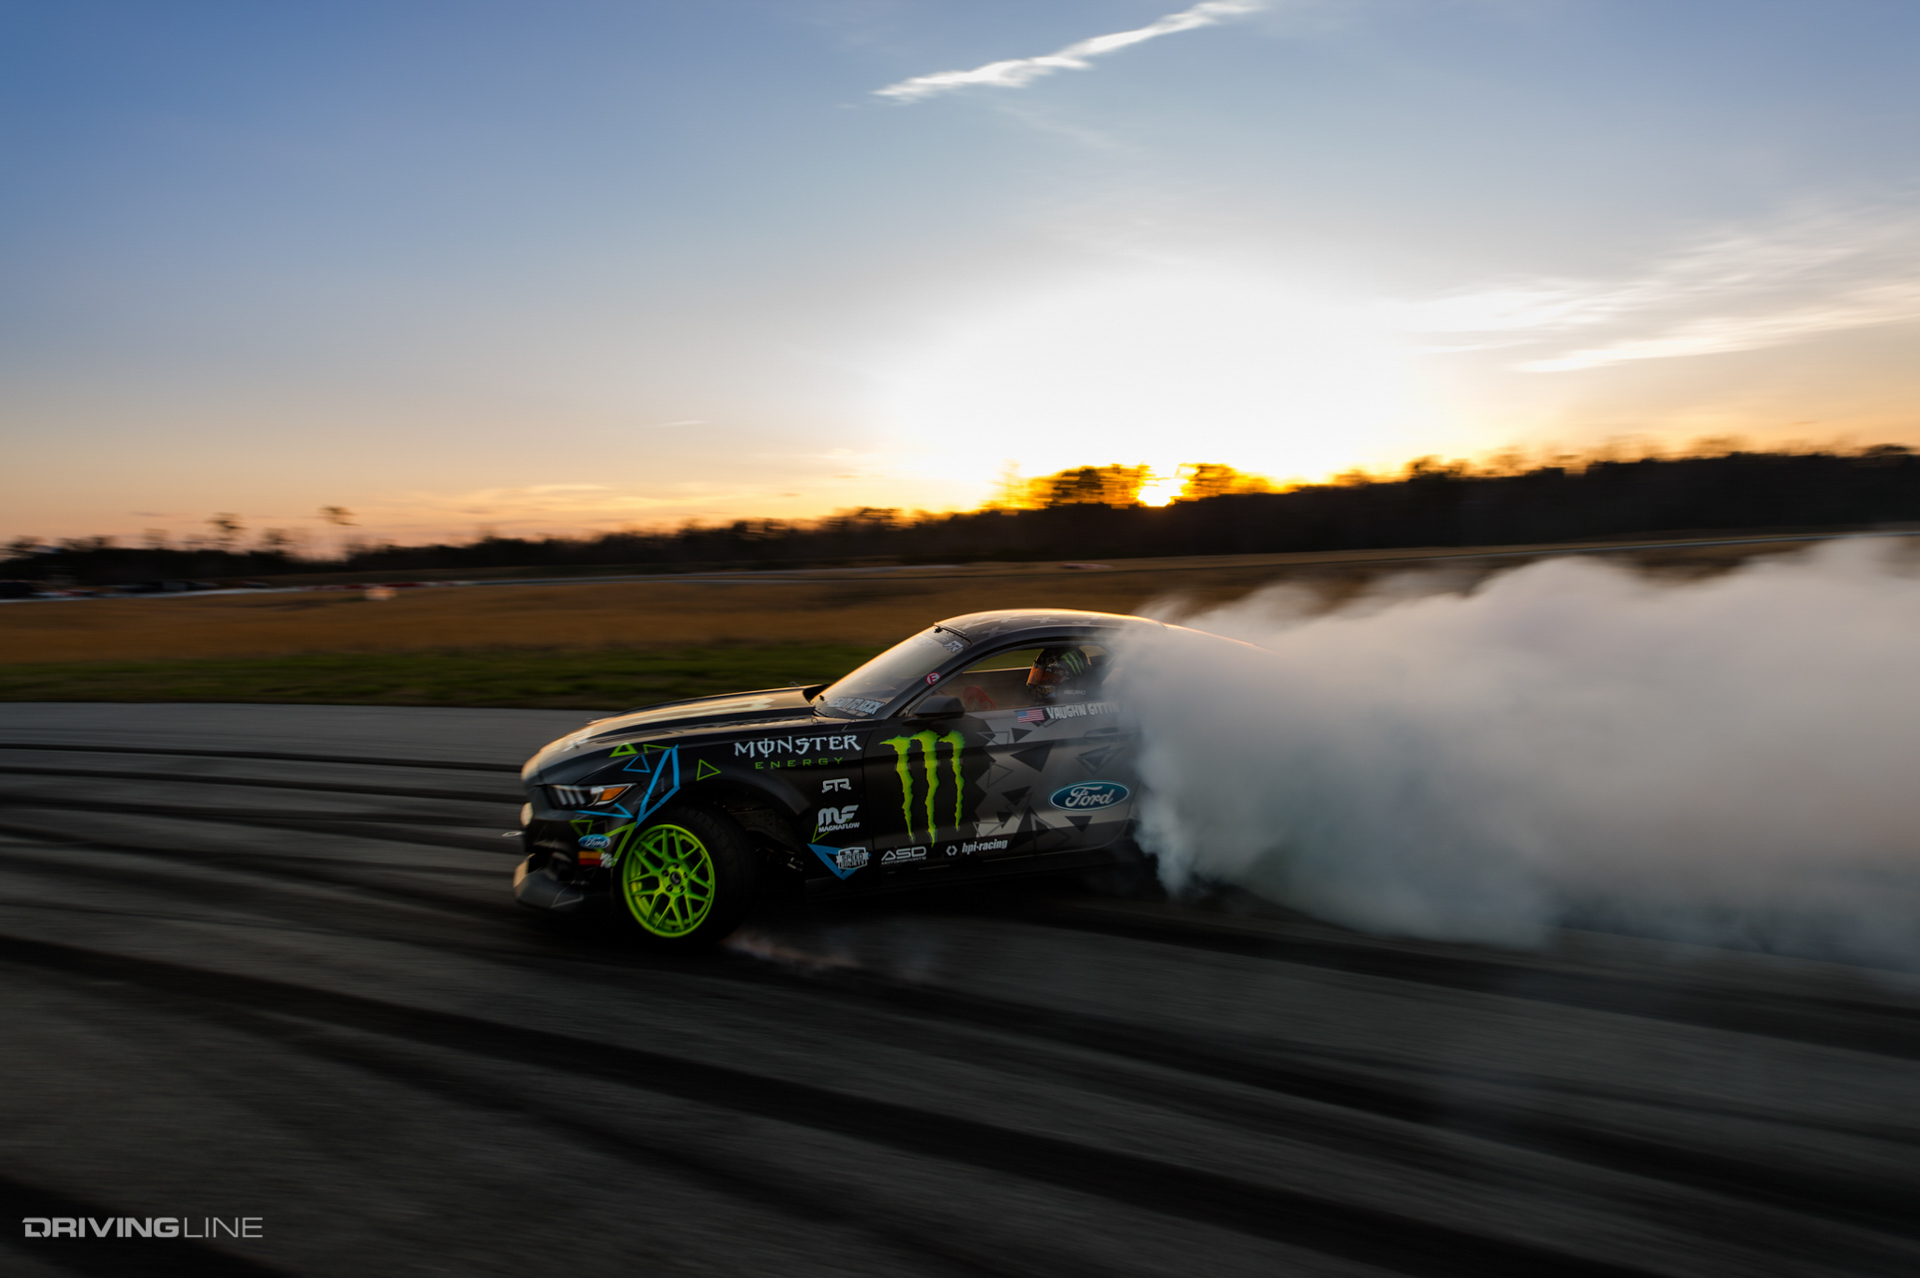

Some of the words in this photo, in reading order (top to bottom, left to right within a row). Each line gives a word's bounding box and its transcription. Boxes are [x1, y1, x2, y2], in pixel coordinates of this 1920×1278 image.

[1046, 703, 1086, 719] VAUGHN
[733, 734, 862, 758] MONSTER
[755, 757, 843, 769] ENERGY
[1065, 785, 1115, 807] Ford
[818, 821, 861, 833] MAGNAFLOW
[841, 853, 864, 862] SPEED
[881, 845, 927, 862] ASD
